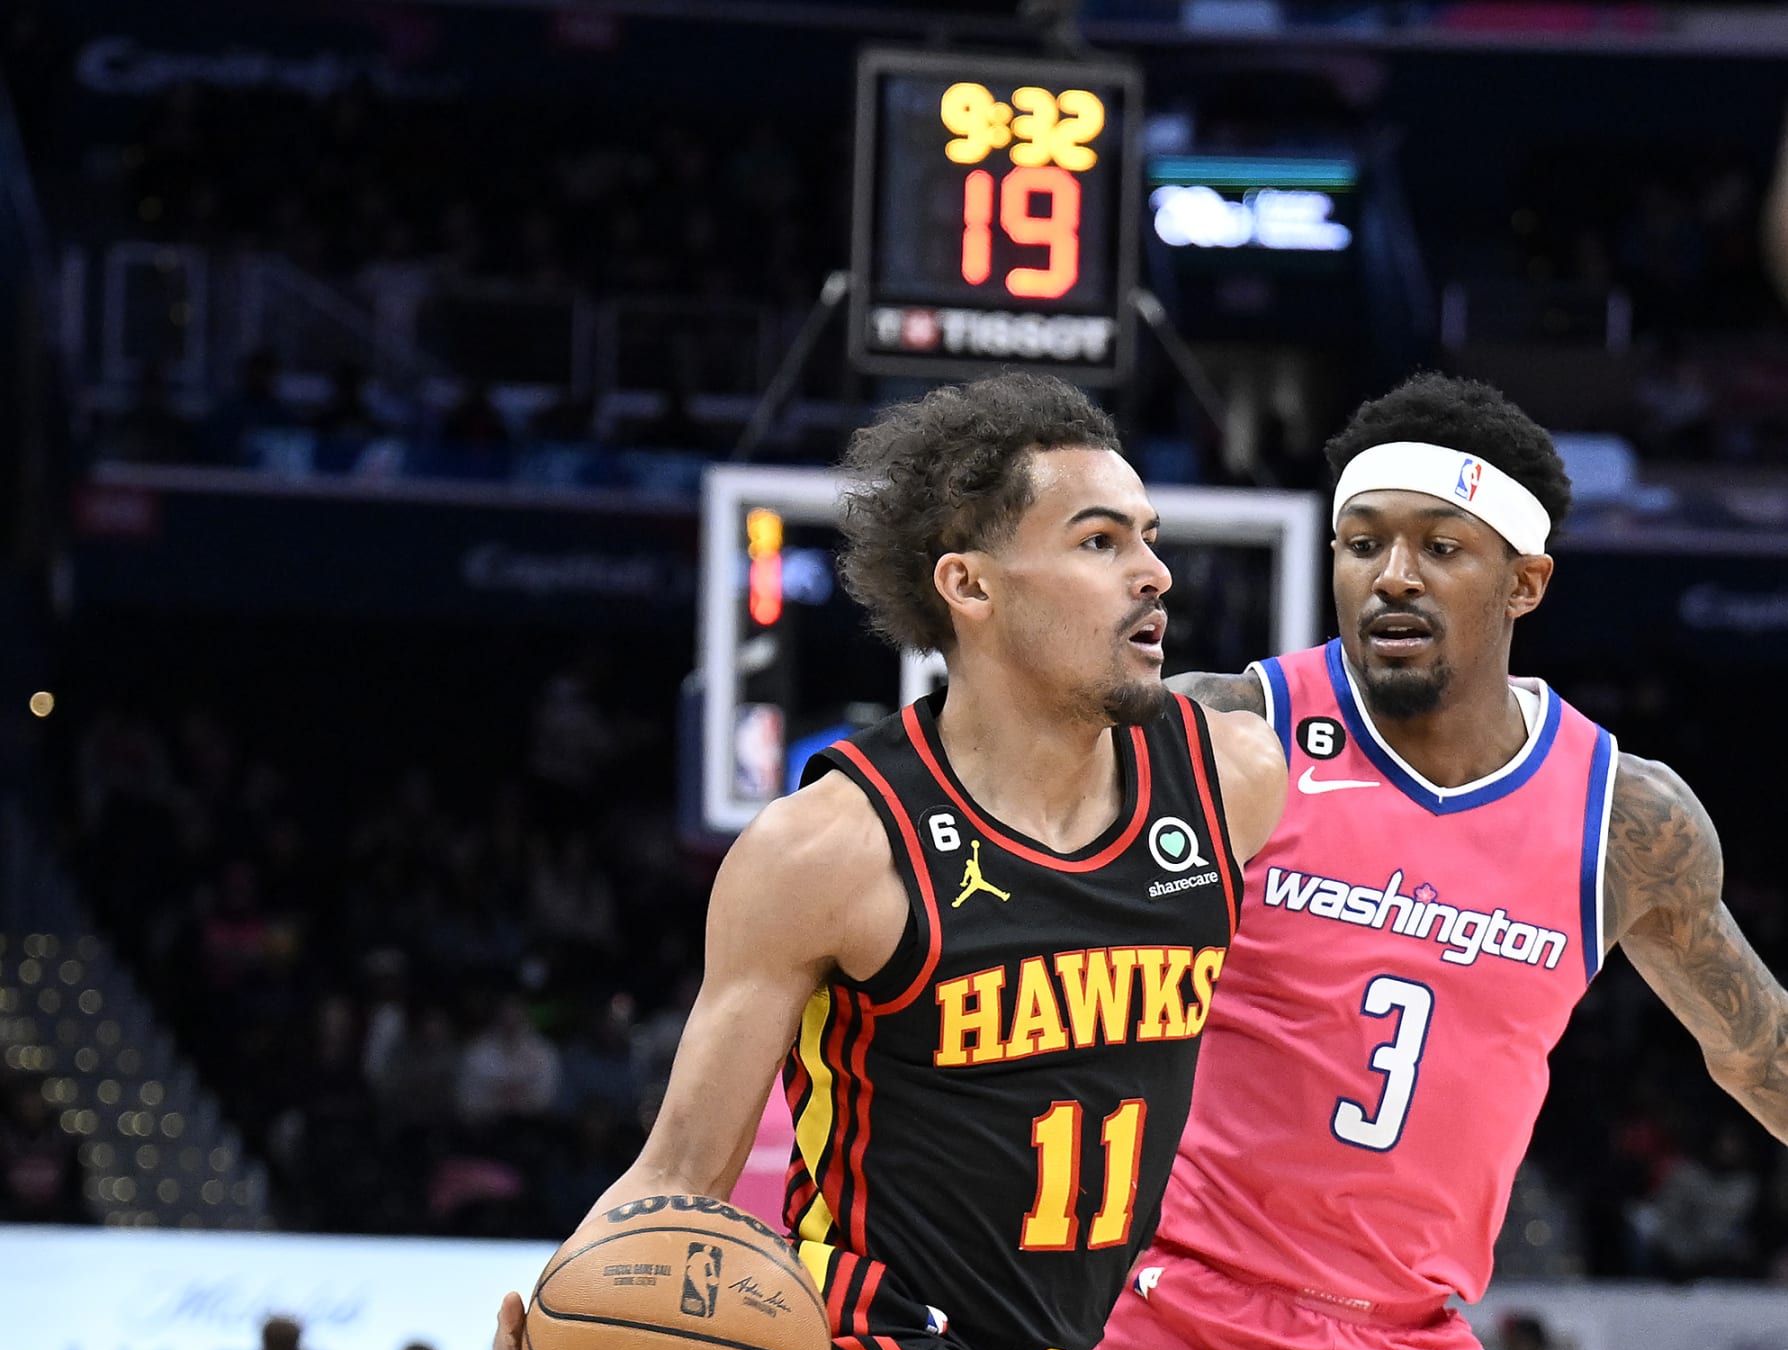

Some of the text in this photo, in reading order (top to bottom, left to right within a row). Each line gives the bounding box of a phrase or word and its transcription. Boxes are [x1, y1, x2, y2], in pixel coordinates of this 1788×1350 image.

[941, 82, 1105, 171] 9:32
[961, 166, 1081, 298] 19
[1306, 722, 1335, 756] 6
[928, 812, 961, 852] 6
[1148, 870, 1218, 898] sharecare
[933, 945, 1226, 1067] HAWKS
[1330, 974, 1434, 1152] 3
[1018, 1098, 1147, 1251] 11
